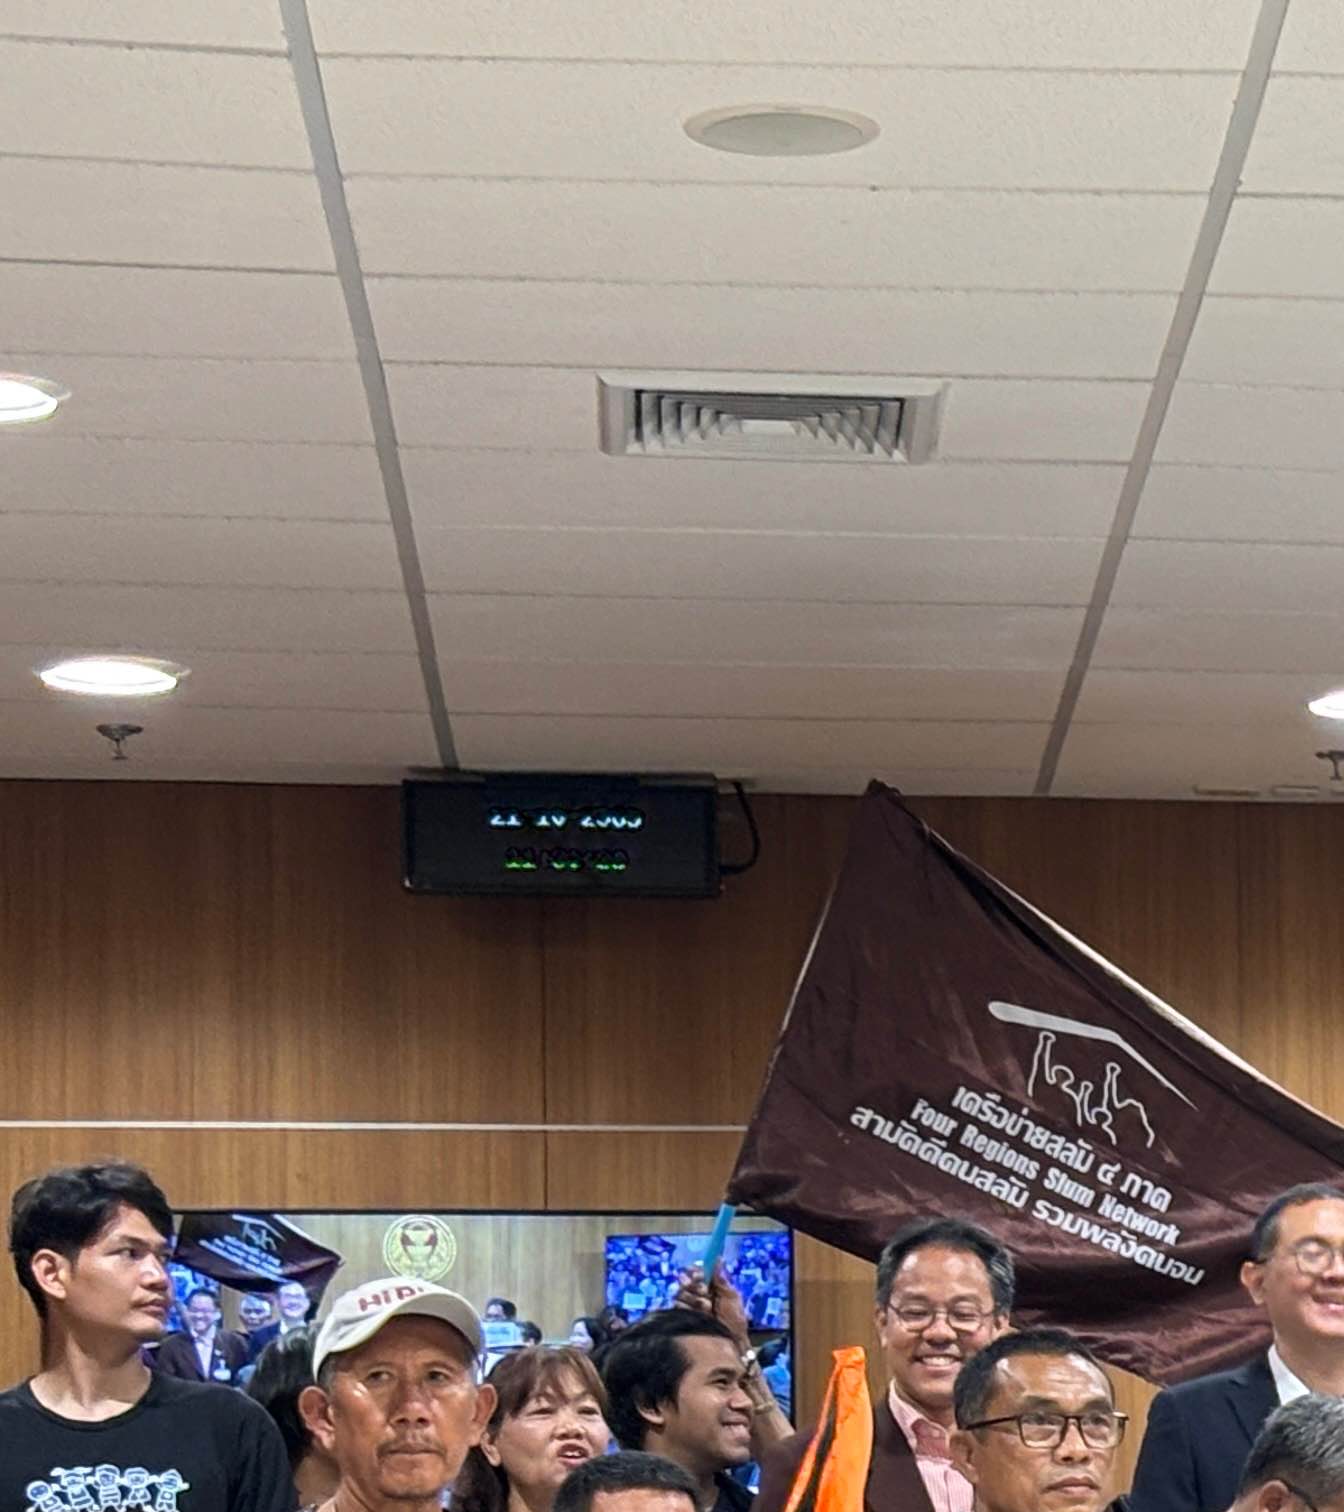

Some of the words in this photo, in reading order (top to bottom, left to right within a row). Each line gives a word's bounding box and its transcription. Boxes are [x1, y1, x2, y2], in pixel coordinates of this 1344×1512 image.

[912, 1099, 955, 1137] Four
[961, 1123, 1039, 1180] Regions
[1045, 1168, 1095, 1207] Slum
[1099, 1193, 1182, 1247] Network
[952, 1086, 1096, 1174] เครือข่ายสลัม
[1119, 1175, 1173, 1214] ภาค
[1032, 1199, 1205, 1286] รวมพลังคนจน
